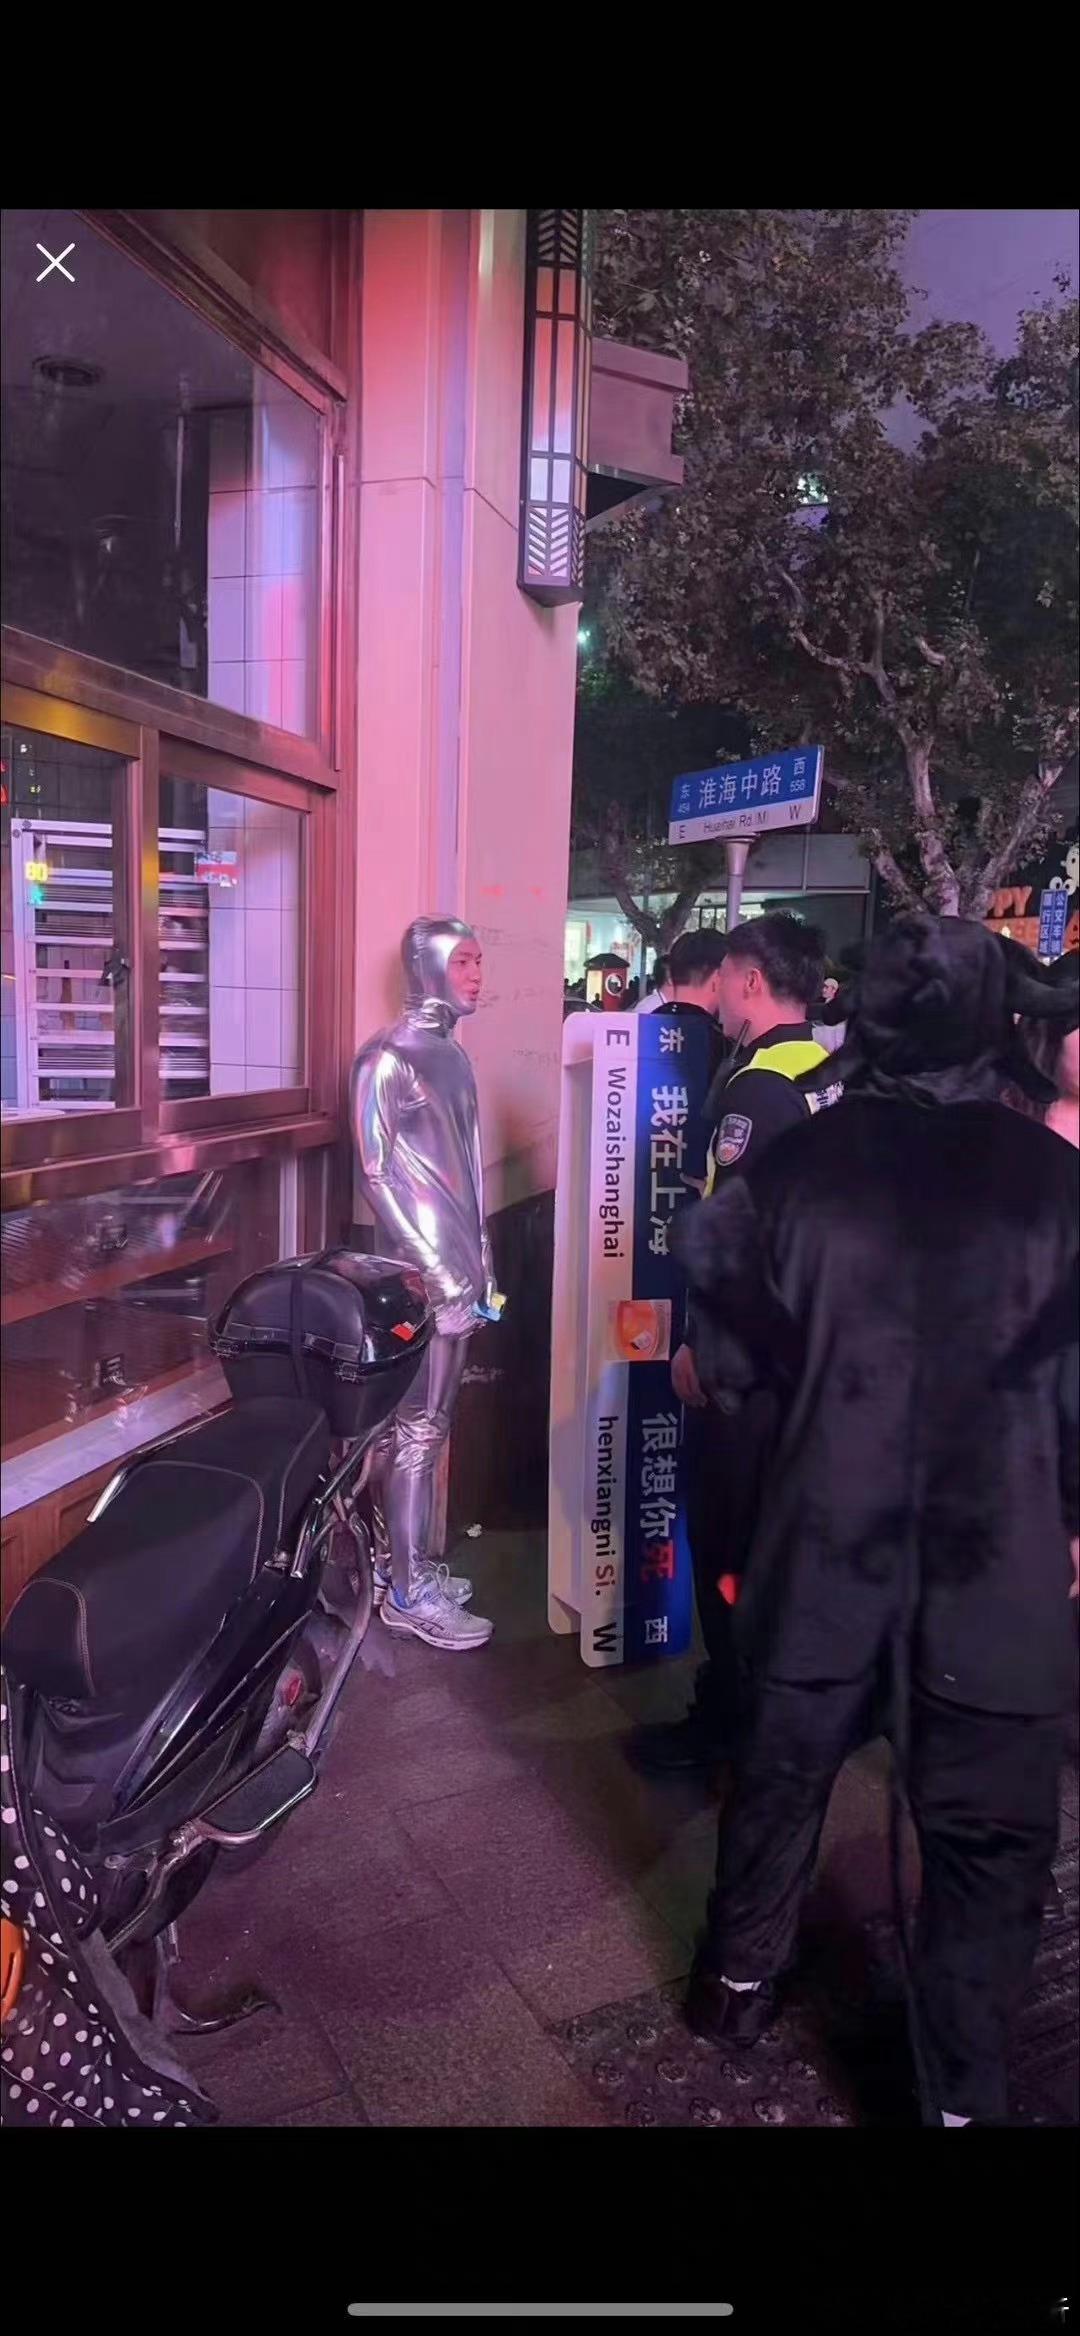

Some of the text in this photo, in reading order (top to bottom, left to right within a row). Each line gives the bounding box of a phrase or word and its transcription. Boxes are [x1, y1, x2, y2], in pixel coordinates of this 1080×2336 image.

[698, 764, 782, 809] 淮海中路
[792, 756, 807, 776] 西
[788, 804, 801, 821] W
[987, 886, 1032, 917] PY
[606, 1028, 630, 1047] E
[659, 1026, 685, 1053] 东
[599, 1066, 627, 1259] Wozaishanghai
[591, 1416, 620, 1557] henxiangni
[640, 1412, 679, 1584] 很想你死
[593, 1622, 618, 1653] W
[645, 1615, 668, 1644] 西
